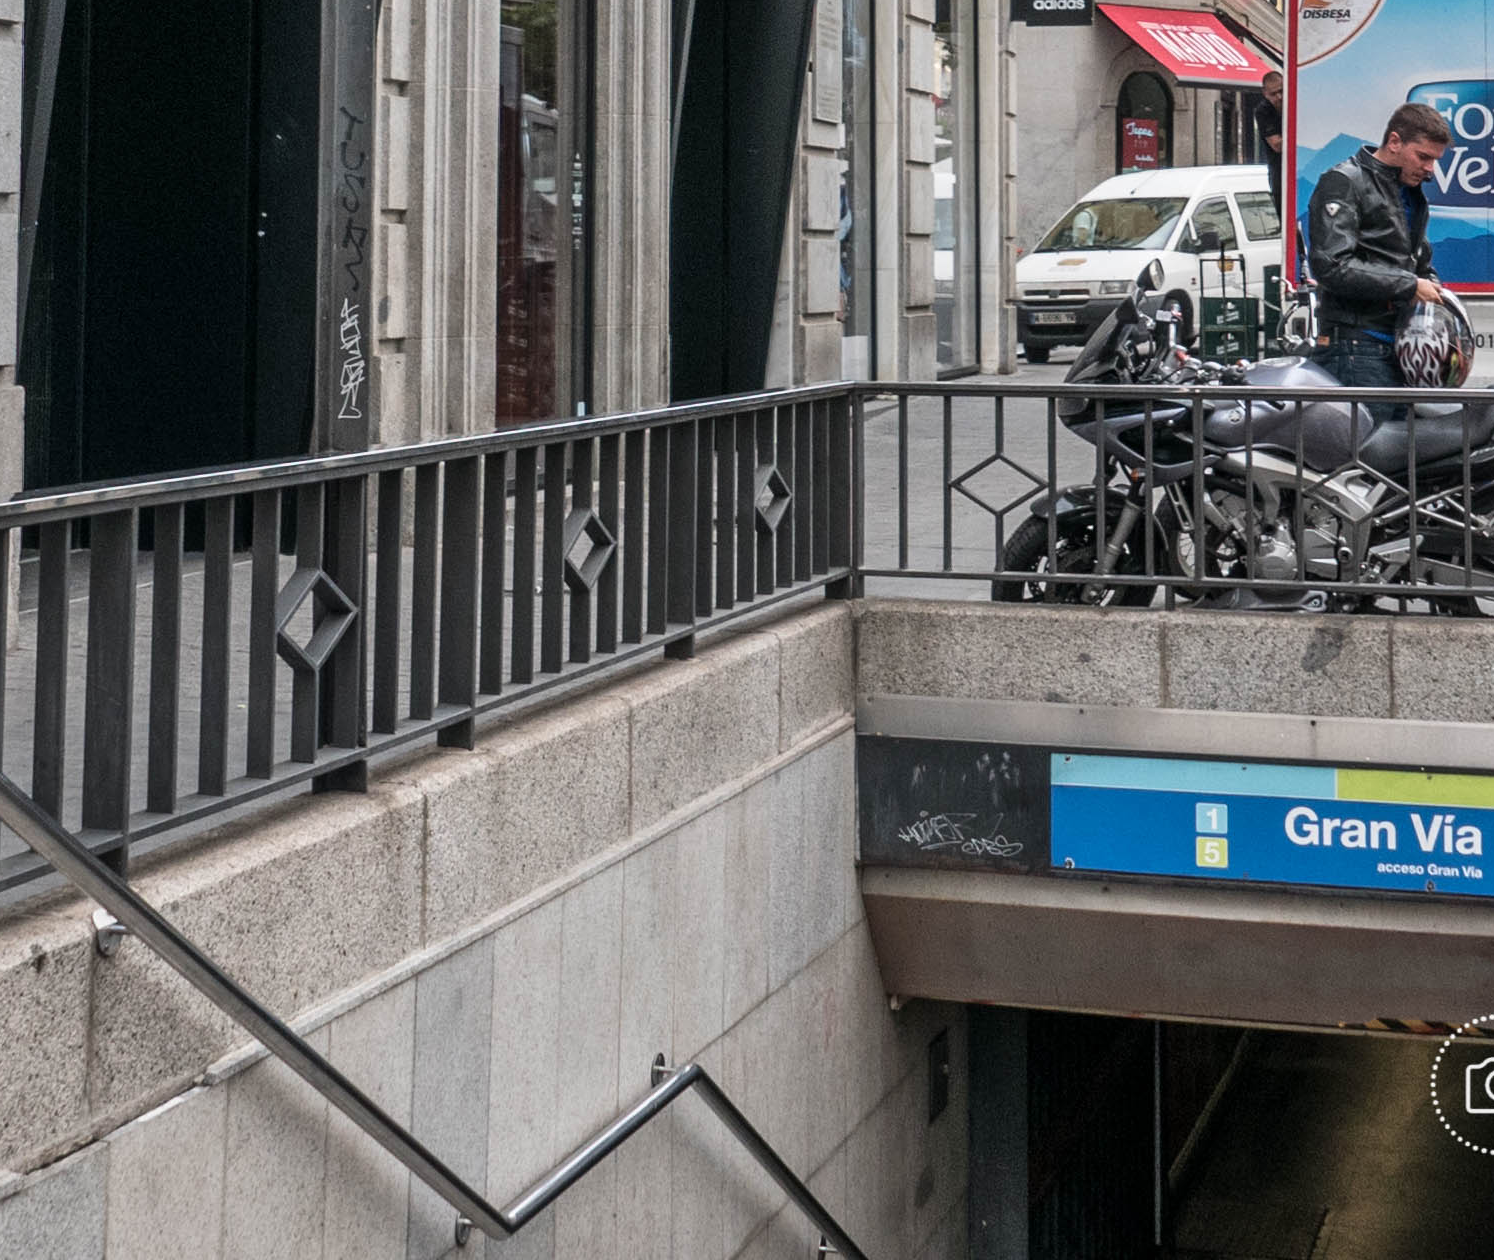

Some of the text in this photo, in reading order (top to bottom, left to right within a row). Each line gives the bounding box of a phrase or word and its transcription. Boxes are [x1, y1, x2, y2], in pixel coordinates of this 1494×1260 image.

[1302, 9, 1351, 19] DISBESA
[1146, 28, 1250, 67] MADRID
[1475, 334, 1494, 348] 01
[1207, 806, 1483, 855] 1 Gran Vía
[1204, 842, 1220, 863] 5
[1377, 862, 1424, 875] acceso
[1427, 863, 1460, 876] Gran
